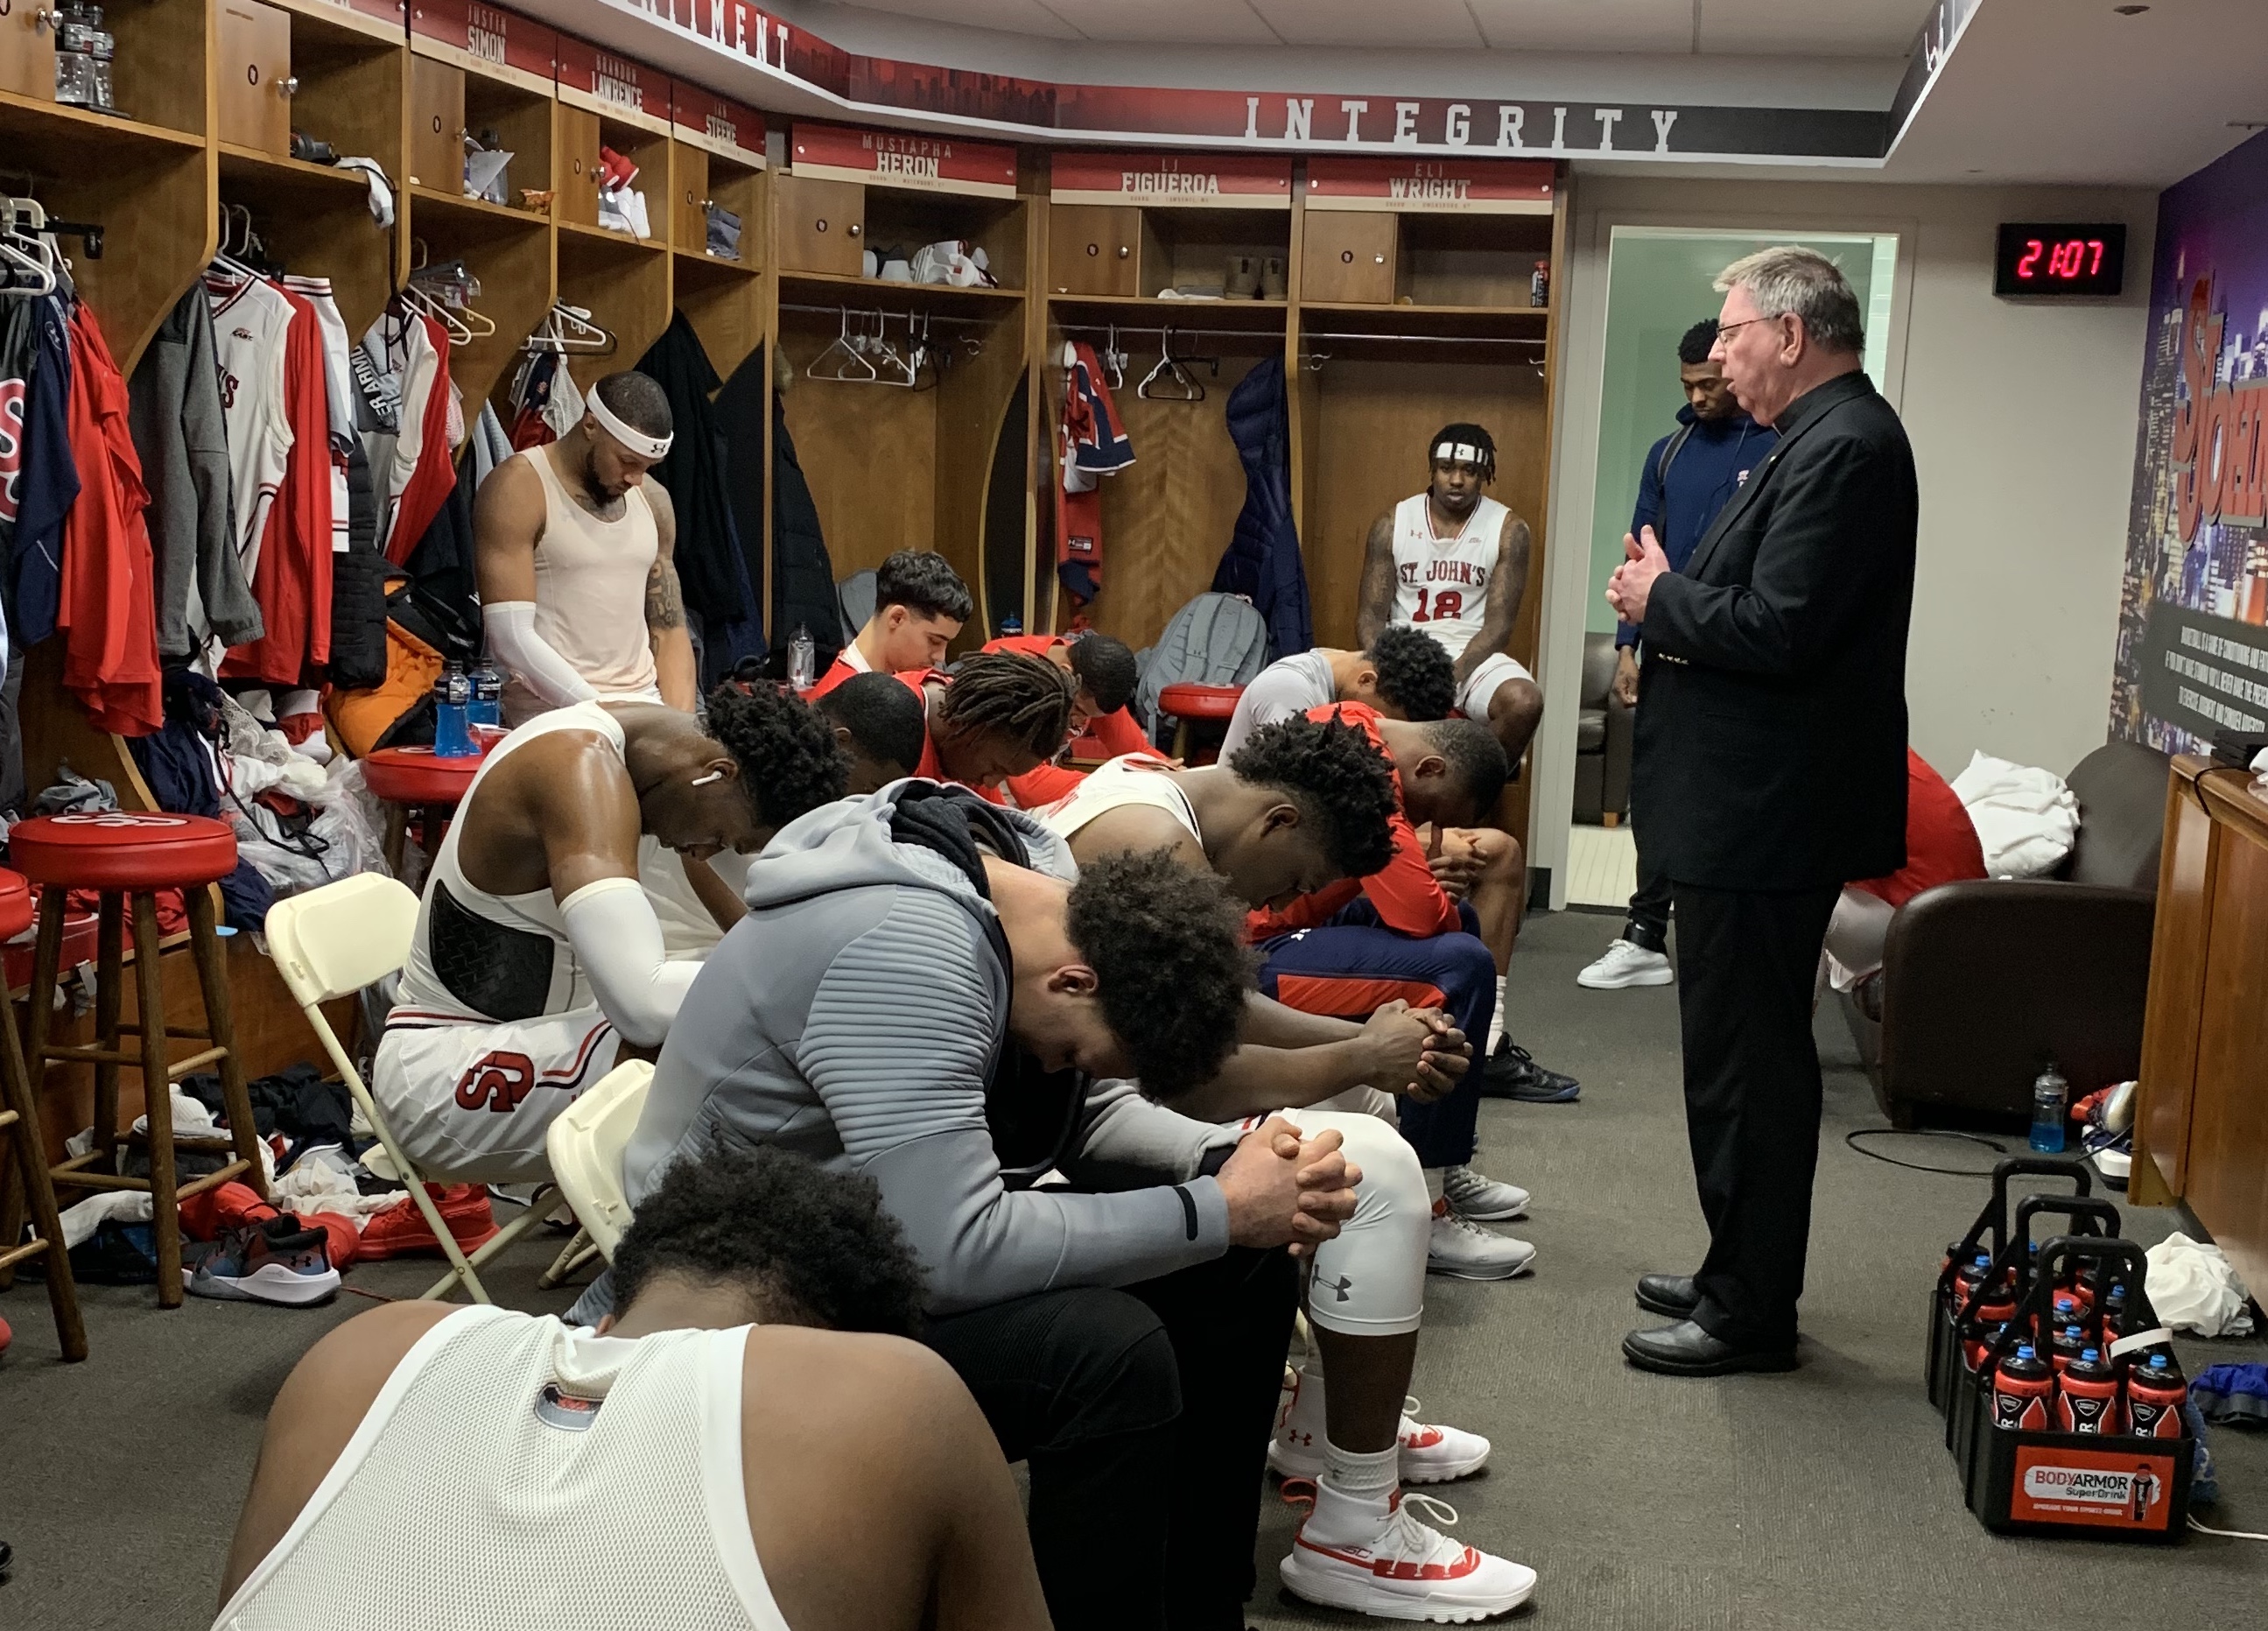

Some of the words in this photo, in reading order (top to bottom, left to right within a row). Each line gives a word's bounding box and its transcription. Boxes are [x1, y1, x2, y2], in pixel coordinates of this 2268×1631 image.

[467, 4, 507, 36] JUSTIN
[467, 25, 506, 66] SIMON
[592, 70, 643, 113] LAWRENCE
[1245, 96, 1678, 153] INTEGRITY
[862, 134, 951, 158] MUSTAPHA
[876, 151, 939, 179] HERON
[1415, 163, 1443, 179] ELI
[1121, 172, 1219, 194] FIGUEROA
[1388, 178, 1471, 200] WRIGHT
[2017, 240, 2103, 278] 21:07
[1401, 561, 1418, 584] ST.
[1426, 560, 1486, 587] JOHN'S
[1412, 587, 1463, 623] 12
[2035, 1470, 2128, 1490] BODYARMOR
[2065, 1487, 2127, 1500] SuperDrink
